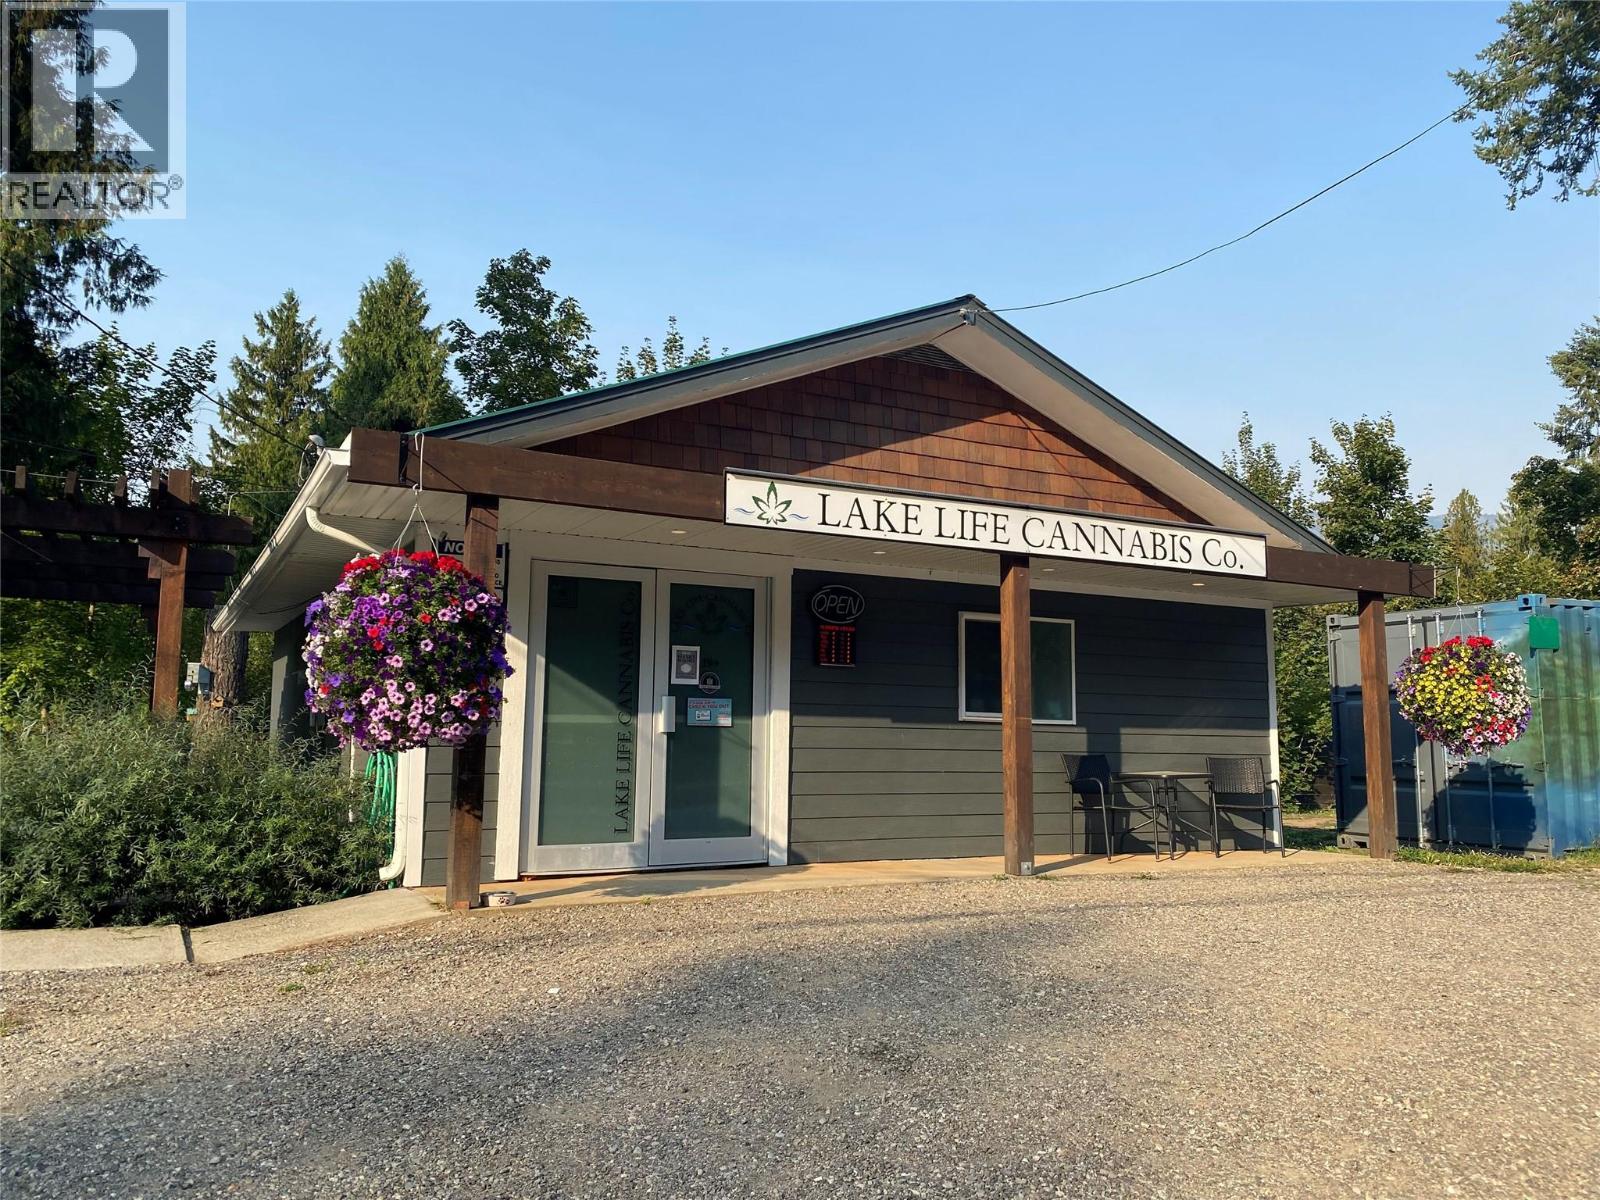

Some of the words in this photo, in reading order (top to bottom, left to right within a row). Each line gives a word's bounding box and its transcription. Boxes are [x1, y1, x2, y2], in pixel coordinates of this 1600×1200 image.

[817, 493, 923, 536] LAKE
[934, 506, 1011, 545] LIFE
[1021, 517, 1192, 564] CANNABIS
[1202, 538, 1245, 570] Co.
[814, 594, 861, 615] OPEN
[618, 621, 634, 726] CANNABIS
[617, 731, 632, 774] LIFE
[614, 779, 631, 834] LAKE
